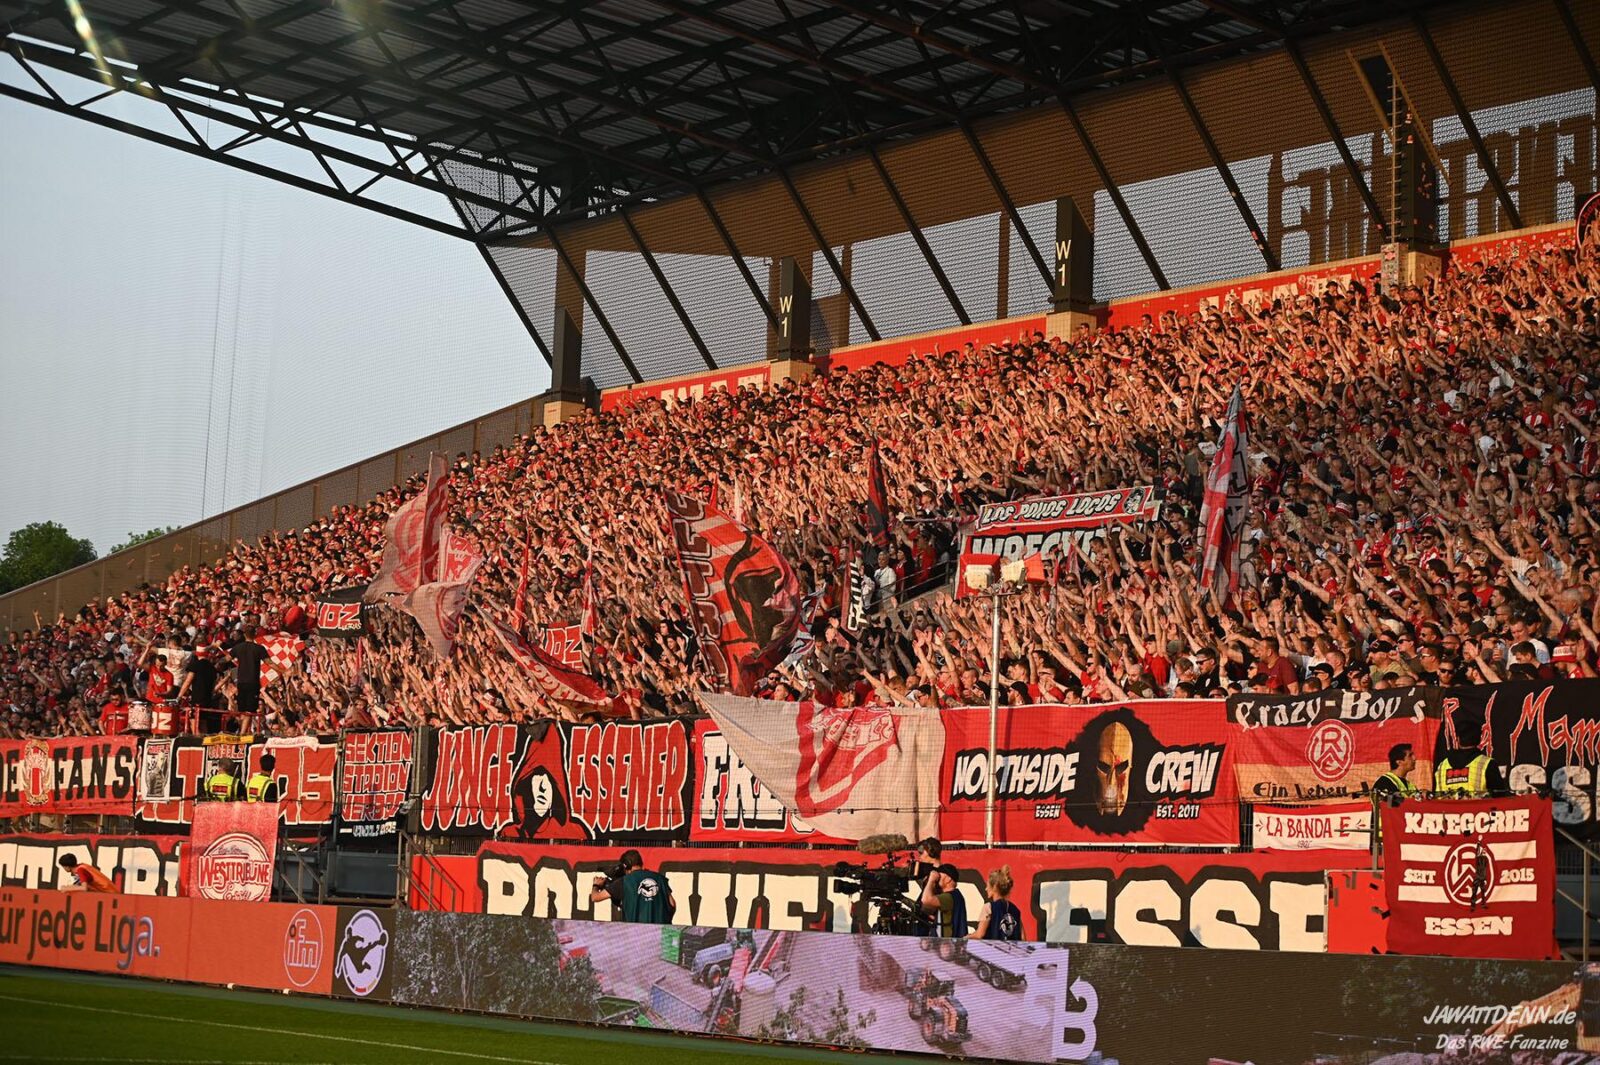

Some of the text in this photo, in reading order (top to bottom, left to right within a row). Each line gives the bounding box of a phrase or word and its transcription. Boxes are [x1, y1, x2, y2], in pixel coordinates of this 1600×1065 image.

[1056, 239, 1072, 260] W
[1058, 266, 1066, 287] 1
[779, 295, 793, 314] W
[781, 317, 789, 338] 1
[1443, 689, 1498, 760] Rd
[345, 732, 412, 763] SEKTION
[0, 749, 19, 803] E
[53, 743, 133, 802] FANS
[343, 762, 410, 793] STADION
[421, 724, 517, 832] JUNGE
[568, 720, 689, 833] ESSENER
[1145, 750, 1219, 794] CREW
[1034, 804, 1061, 819] ESSEN
[1155, 803, 1200, 818] EST. 2011
[1266, 815, 1352, 839] LA BANDA E
[1403, 868, 1437, 884] SEIT
[1500, 867, 1535, 884] 2015
[27, 894, 87, 961] jede
[95, 900, 161, 970] Liga.
[1424, 915, 1513, 936] ESSEN
[286, 918, 320, 969] ifm
